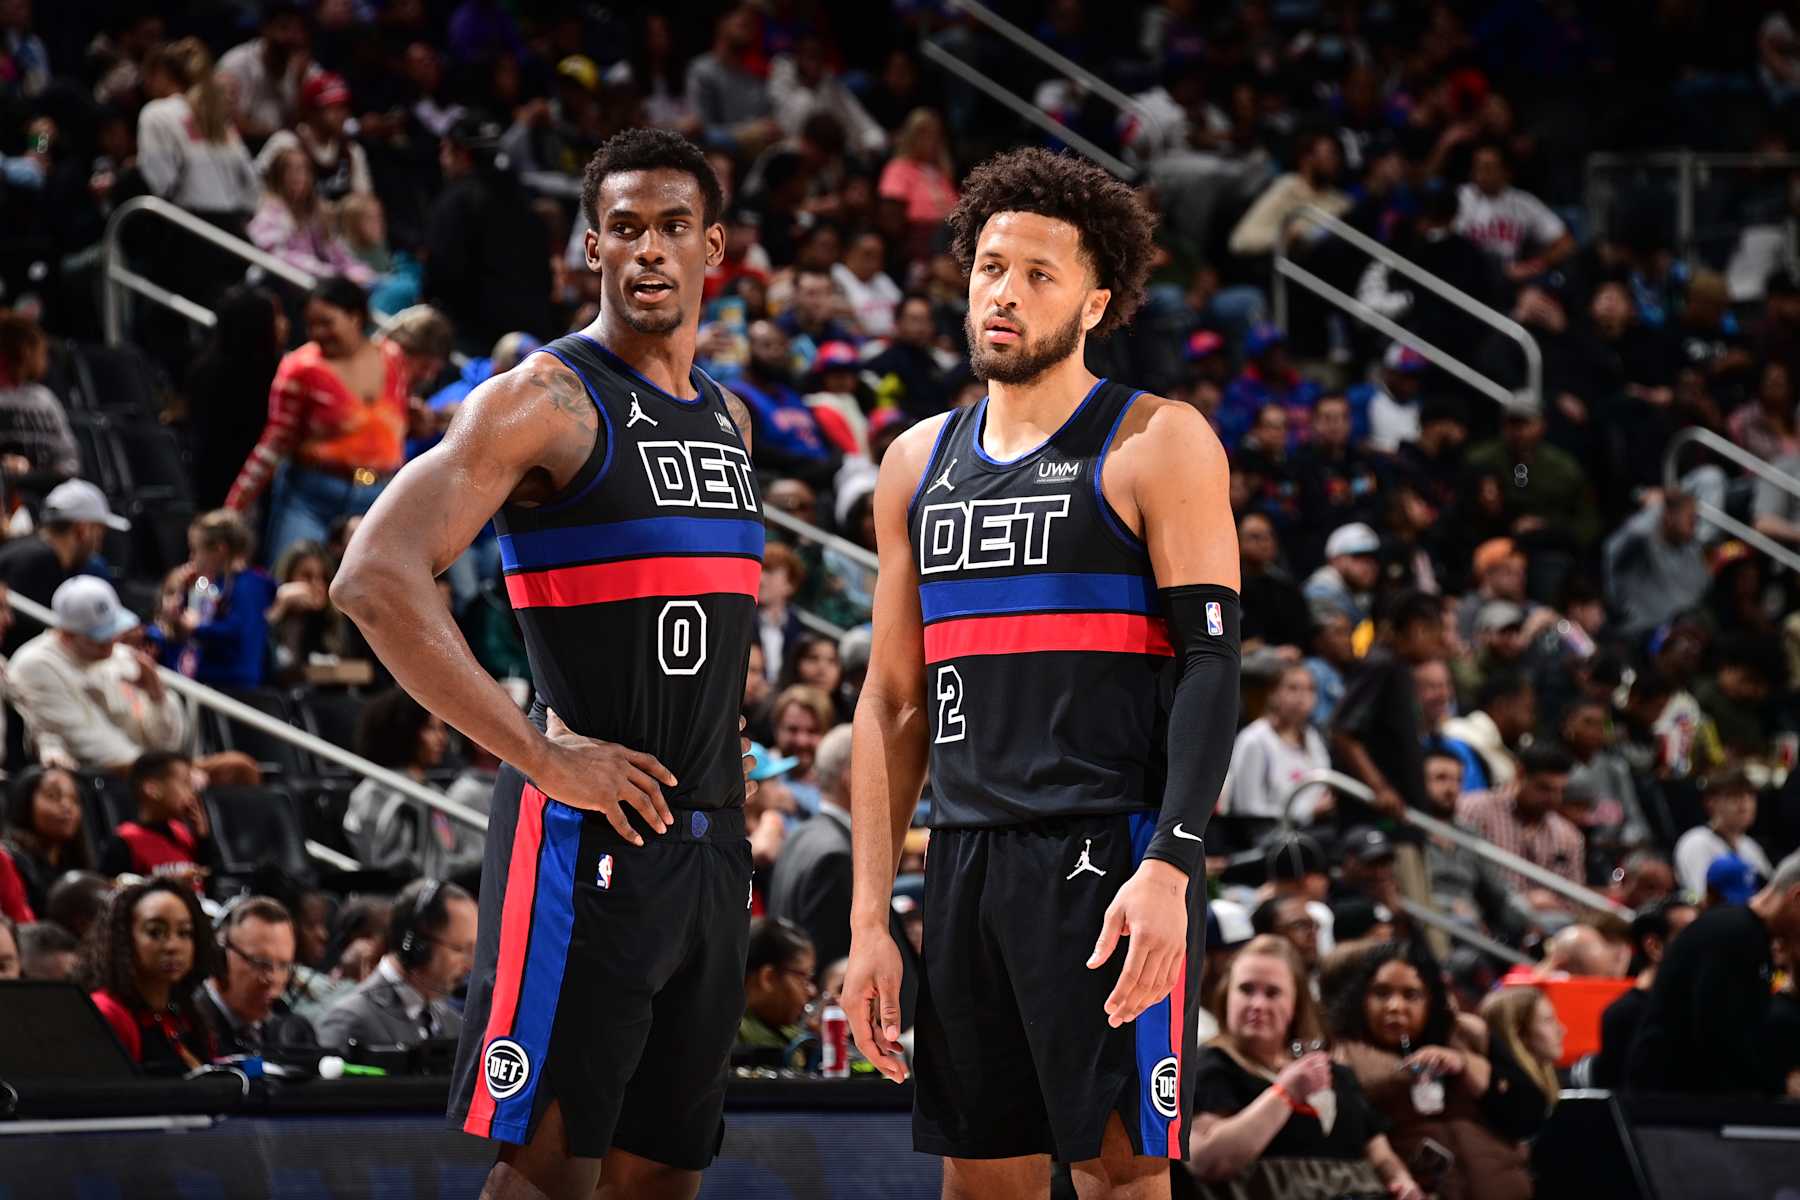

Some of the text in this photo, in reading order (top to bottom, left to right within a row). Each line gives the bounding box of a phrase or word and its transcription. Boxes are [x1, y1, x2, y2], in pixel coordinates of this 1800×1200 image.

[637, 440, 758, 513] DET
[1039, 462, 1079, 477] UWM
[920, 494, 1071, 575] DET
[658, 600, 707, 676] 0
[934, 664, 966, 744] 2
[490, 1055, 521, 1082] DET
[1158, 1076, 1176, 1098] DE
